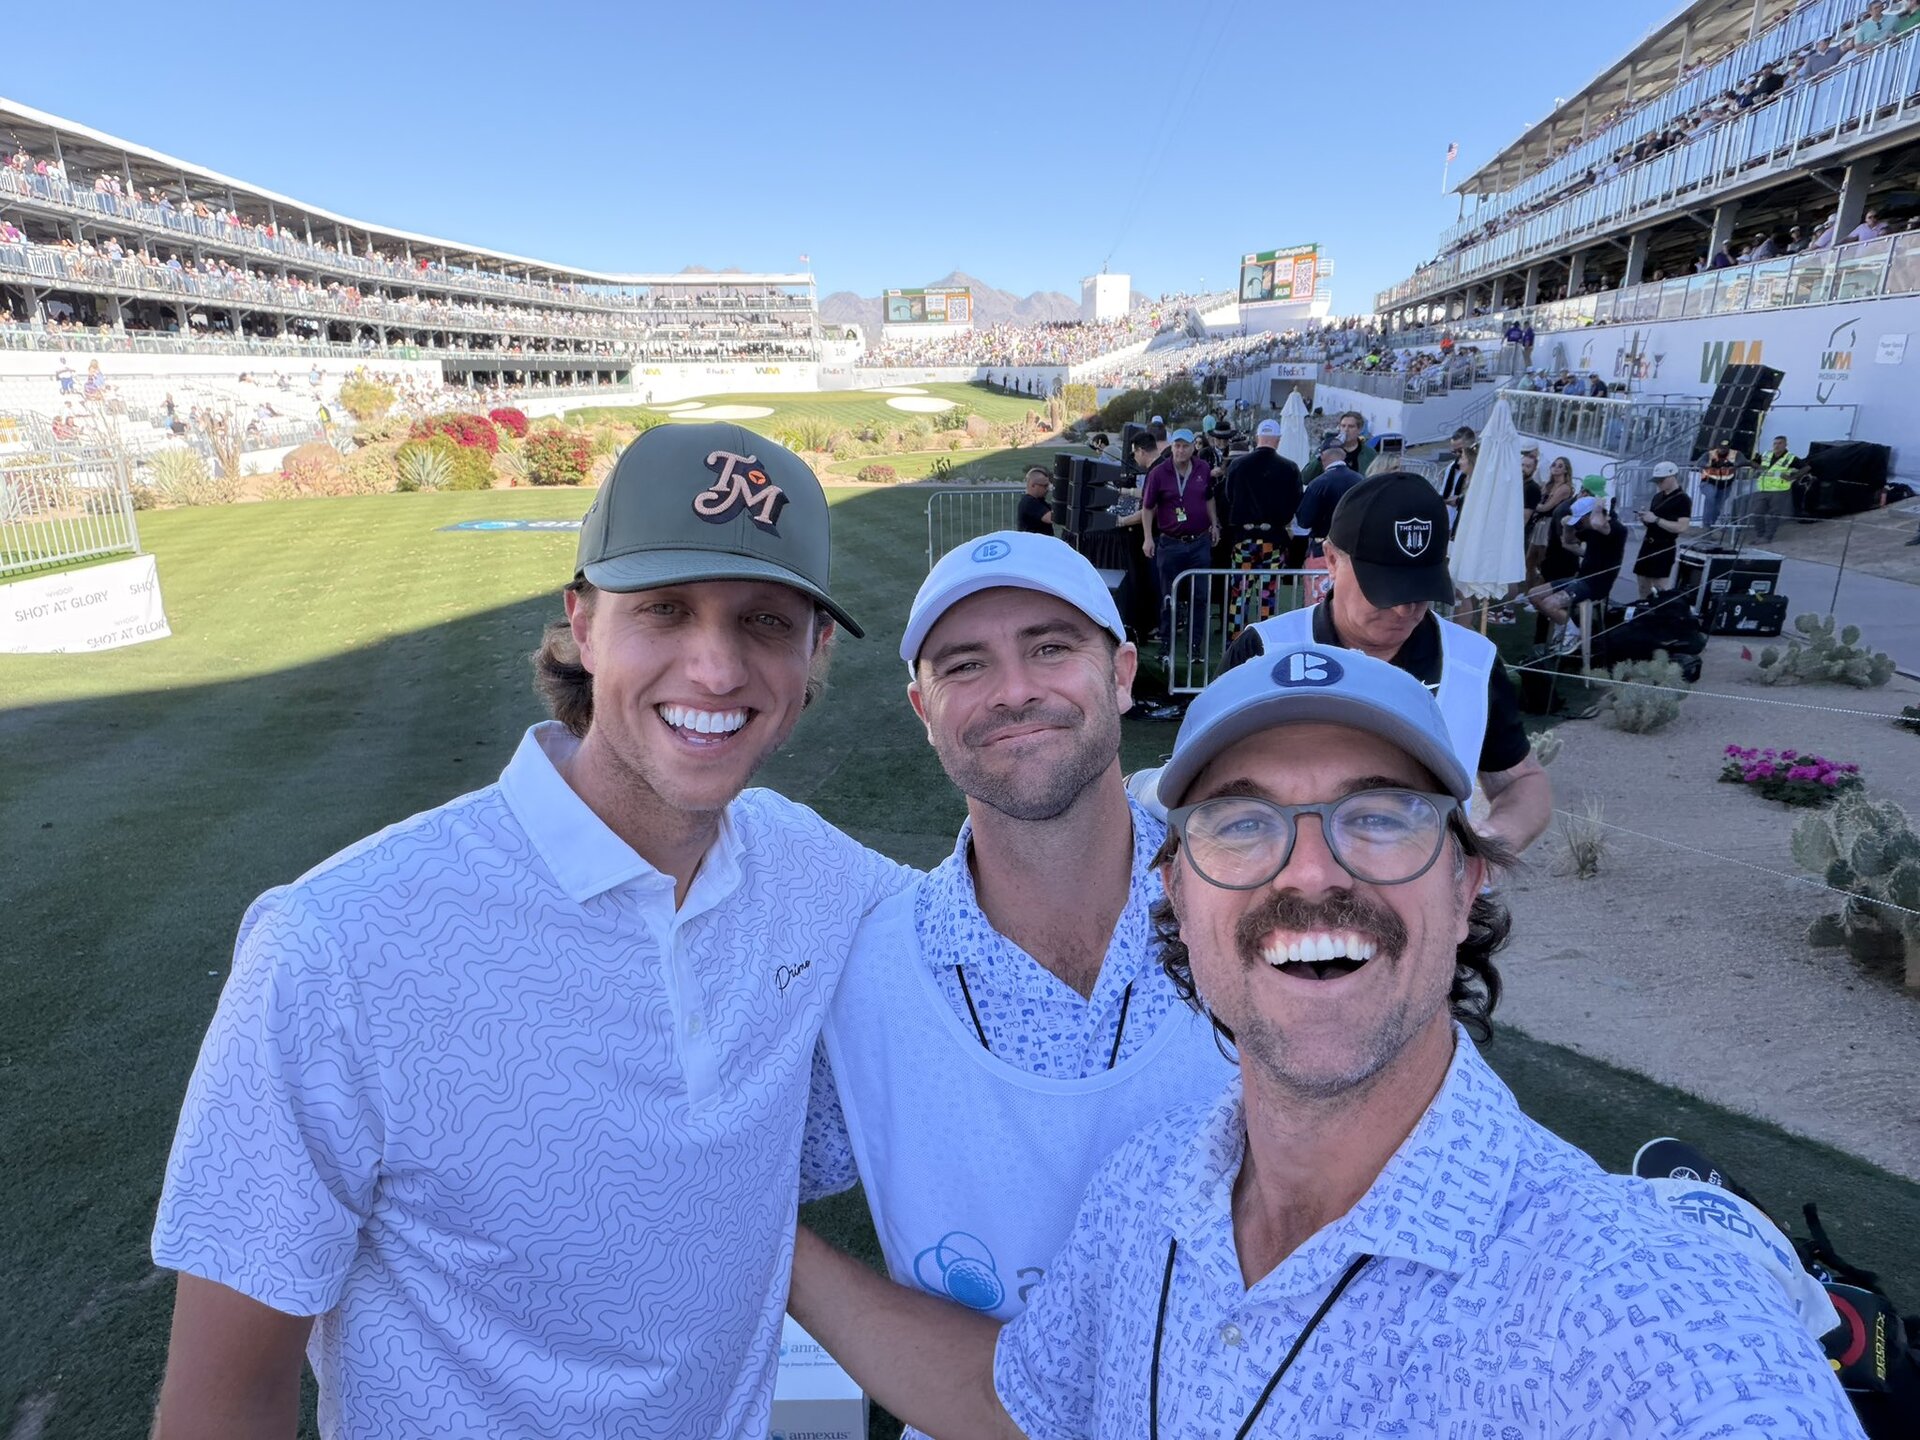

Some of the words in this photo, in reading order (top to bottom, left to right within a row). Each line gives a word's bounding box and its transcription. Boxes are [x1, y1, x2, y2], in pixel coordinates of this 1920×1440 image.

[1820, 351, 1852, 370] WM
[15, 603, 50, 622] SHOT
[53, 599, 68, 614] AT
[70, 589, 109, 609] GLORY
[86, 632, 118, 649] SHOT
[120, 627, 134, 641] AT
[788, 1427, 849, 1440] annexus
